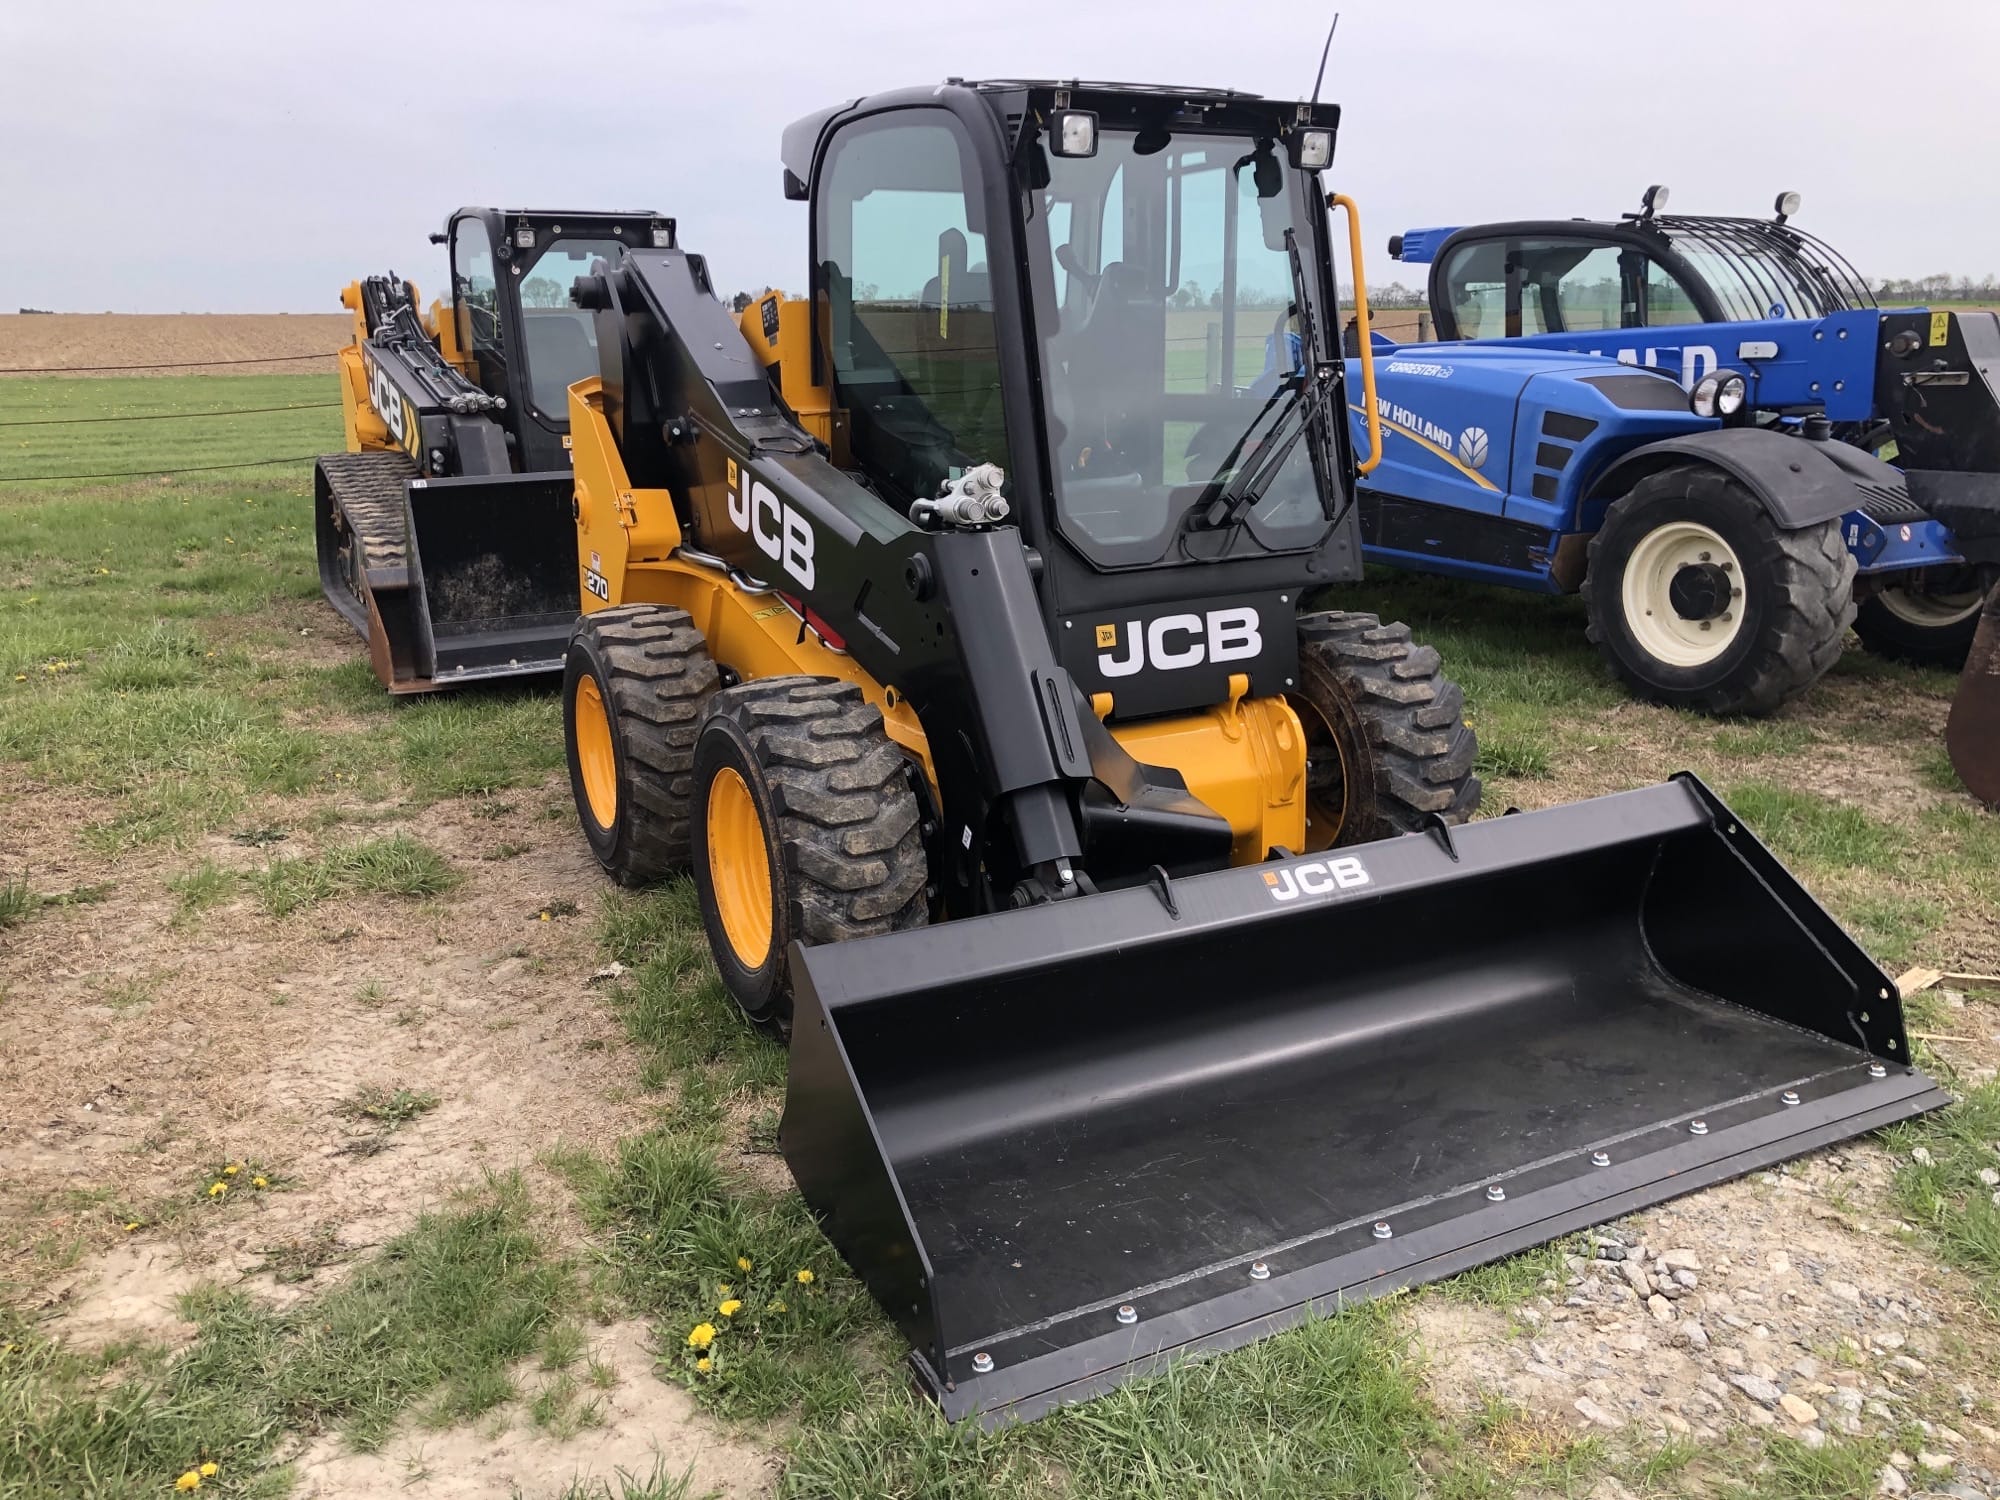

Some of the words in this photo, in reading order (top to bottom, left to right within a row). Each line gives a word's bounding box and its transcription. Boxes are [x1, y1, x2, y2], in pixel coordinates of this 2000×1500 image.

[369, 363, 402, 440] JCB
[1392, 404, 1453, 450] HOLLAND
[728, 469, 815, 591] JCB
[588, 571, 608, 600] 270
[1098, 607, 1263, 677] JCB
[1271, 857, 1369, 900] JCB
